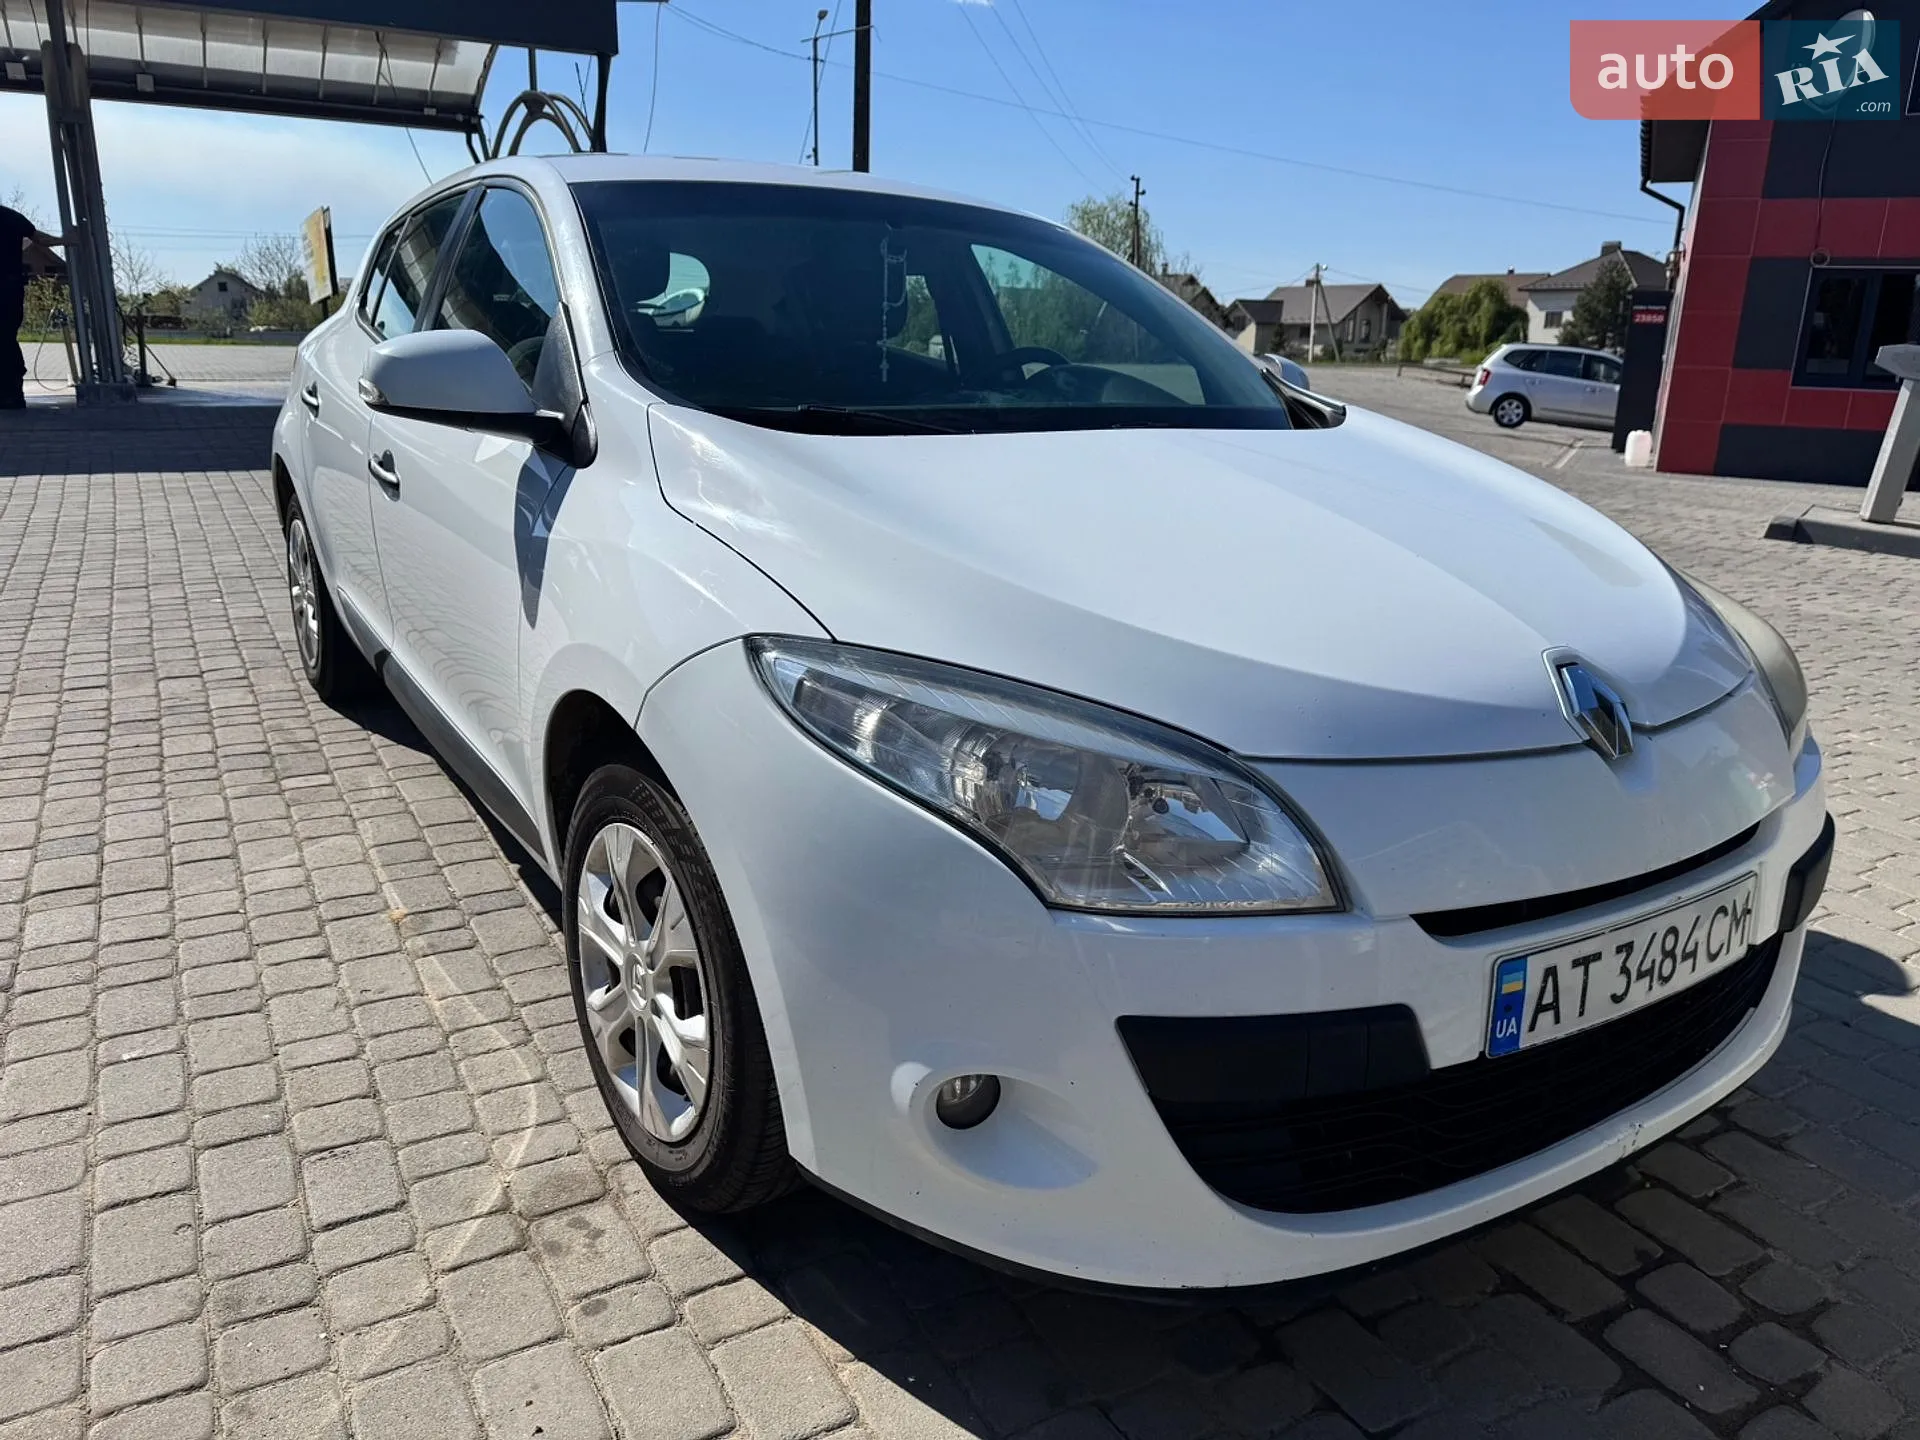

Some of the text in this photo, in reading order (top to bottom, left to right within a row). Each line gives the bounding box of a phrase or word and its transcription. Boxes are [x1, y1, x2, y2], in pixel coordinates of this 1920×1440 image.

[1528, 891, 1751, 1033] AT 3484 CM
[1495, 1015, 1518, 1039] UA
